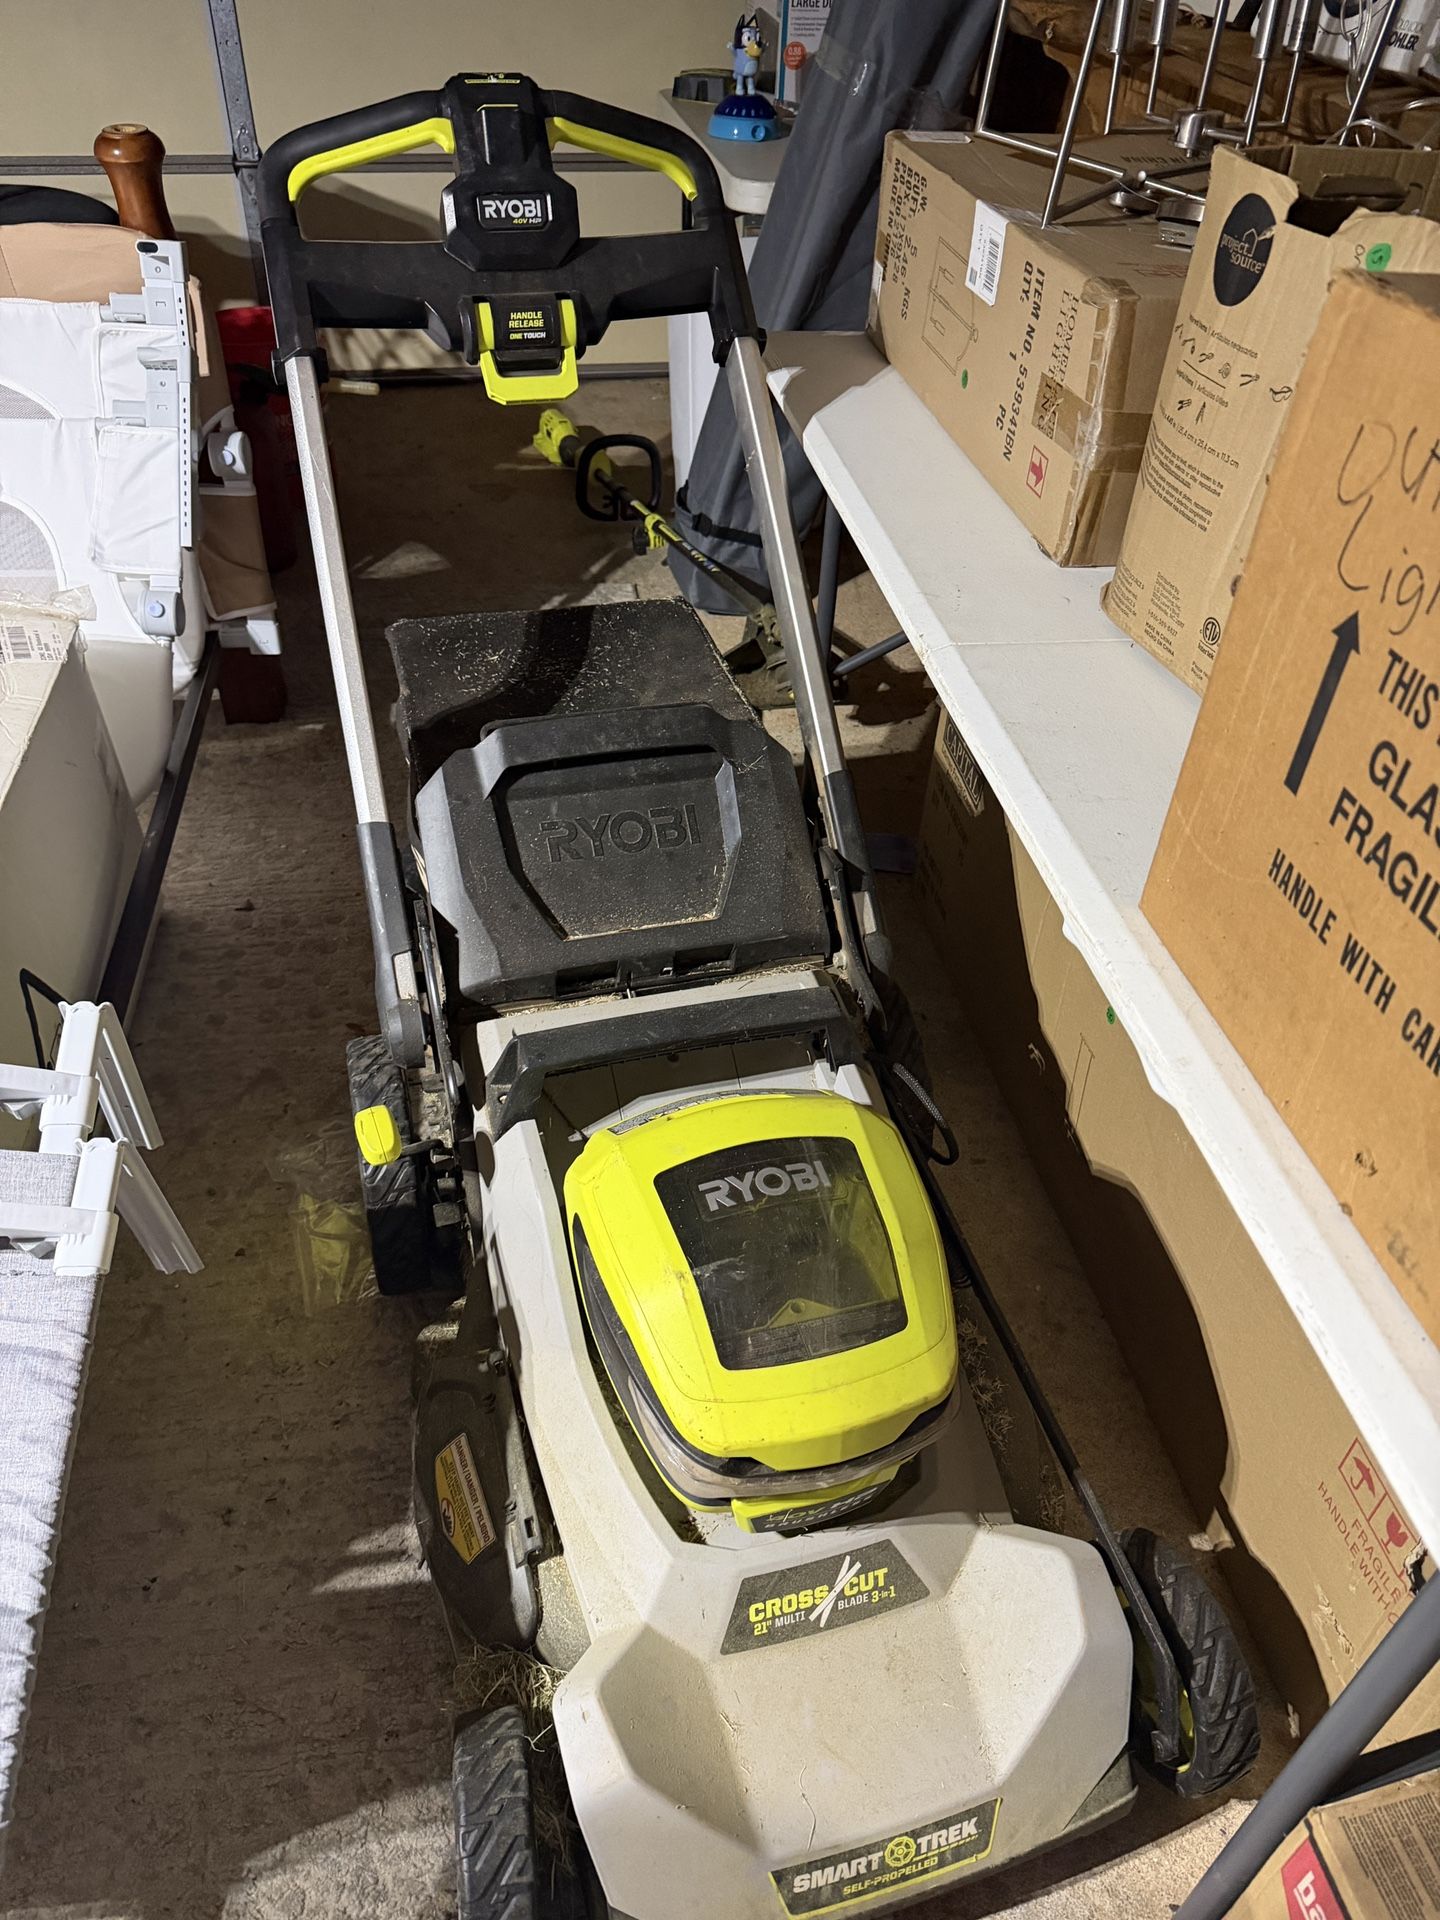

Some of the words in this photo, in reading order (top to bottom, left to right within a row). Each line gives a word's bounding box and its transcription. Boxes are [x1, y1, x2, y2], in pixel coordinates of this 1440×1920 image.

[1388, 31, 1419, 50] OHLER
[889, 158, 901, 206] MADE
[482, 199, 542, 218] RYOBI
[887, 211, 895, 229] IN
[1220, 232, 1250, 255] project
[1230, 251, 1262, 274] source
[510, 311, 543, 320] HANDLE
[901, 287, 911, 321] KGS
[1033, 268, 1046, 321] ITEM
[508, 319, 545, 328] RELEASE
[509, 332, 523, 341] ONE
[523, 331, 546, 340] TOUCH
[1021, 326, 1036, 358] NO.
[1009, 351, 1017, 362] 1
[995, 404, 1007, 432] PC
[1004, 363, 1028, 462] 539341BN
[1378, 648, 1439, 731] THIS
[946, 723, 980, 799] CAPITAL
[1368, 740, 1440, 849] GLA
[539, 803, 701, 863] RYOBI
[1329, 786, 1440, 937] FRAGIL
[1268, 848, 1337, 946] HANDLE
[1339, 932, 1397, 1015] WITH
[697, 1160, 832, 1212] RYOBI
[1318, 1481, 1361, 1560] HANDLE
[1359, 1557, 1391, 1611] WITH
[1350, 1517, 1402, 1605] FRAGILE
[749, 1584, 829, 1622] CROSS
[843, 1567, 889, 1597] CUT
[753, 1619, 772, 1636] 21"
[775, 1610, 806, 1628] MULTI
[838, 1592, 869, 1610] BLADE
[871, 1585, 896, 1604] 3-in-1
[792, 1850, 884, 1894] SMART
[916, 1816, 979, 1854] TREK
[842, 1856, 939, 1896] SELF-PROPELLED
